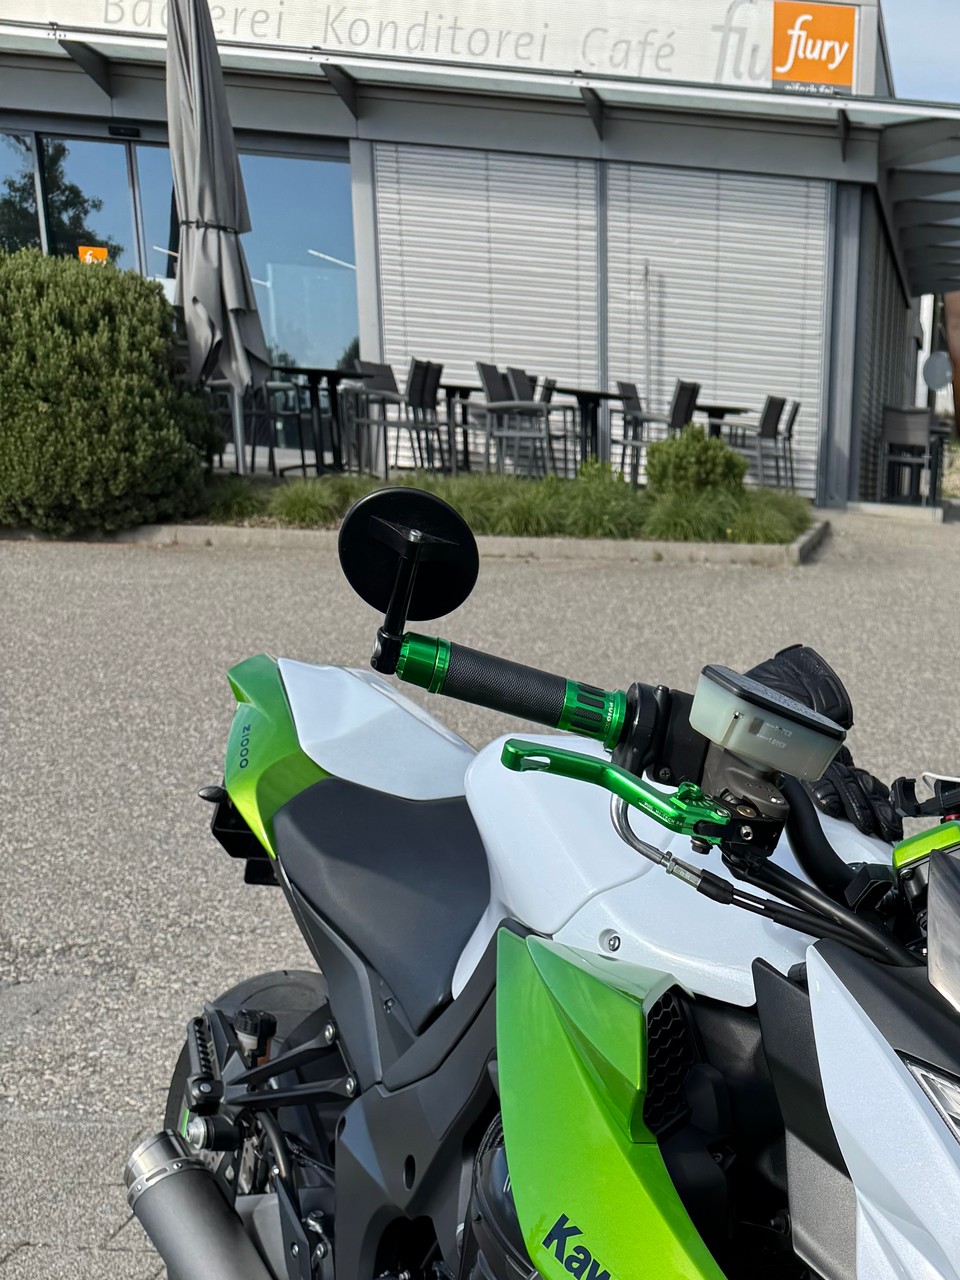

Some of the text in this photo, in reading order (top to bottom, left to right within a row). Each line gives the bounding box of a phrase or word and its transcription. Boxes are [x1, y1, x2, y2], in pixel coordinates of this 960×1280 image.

[322, 5, 550, 63] Konditorei
[581, 27, 676, 76] Café
[775, 14, 849, 74] flury
